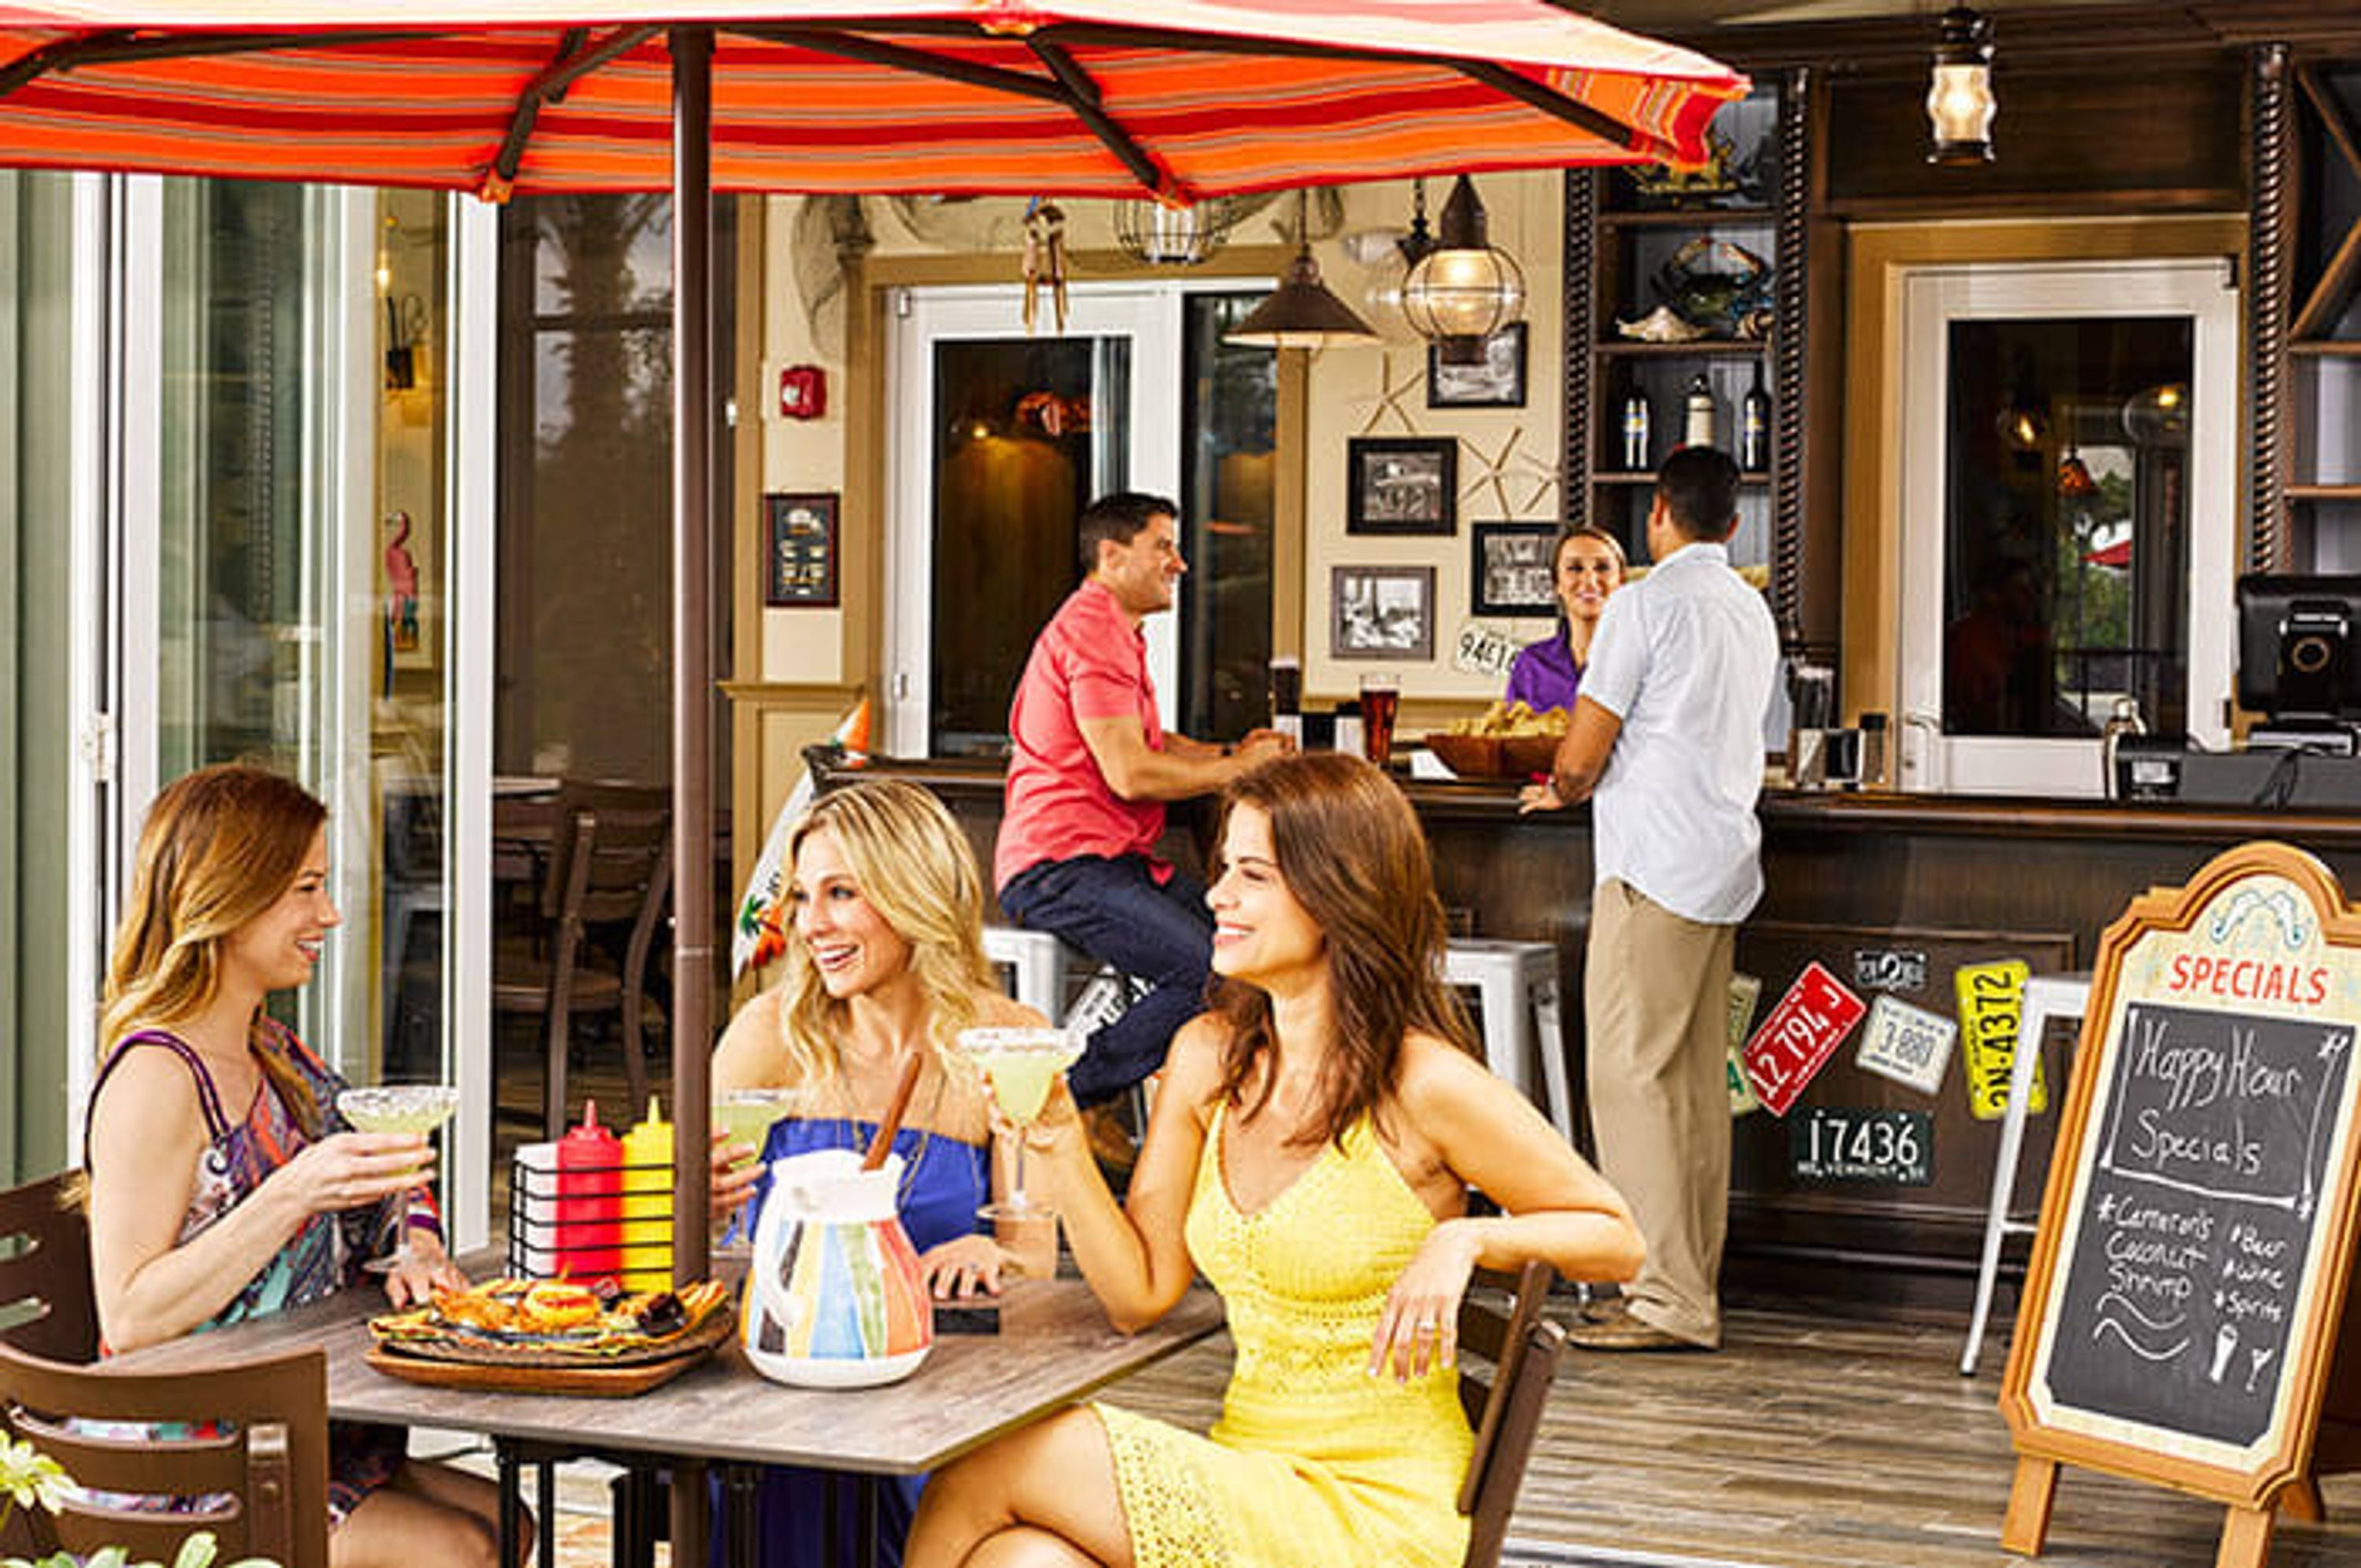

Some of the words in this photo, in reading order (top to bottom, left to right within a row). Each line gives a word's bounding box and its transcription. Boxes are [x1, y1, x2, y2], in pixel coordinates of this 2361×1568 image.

[2168, 954, 2328, 1005] SPECIALS
[2135, 1019, 2226, 1112] Happy
[2225, 1024, 2302, 1098] Hour
[1810, 1118, 1919, 1166] 17436
[2131, 1108, 2261, 1175] Specials
[2104, 1230, 2208, 1270] Coconut
[2106, 1260, 2193, 1309] Shrimp
